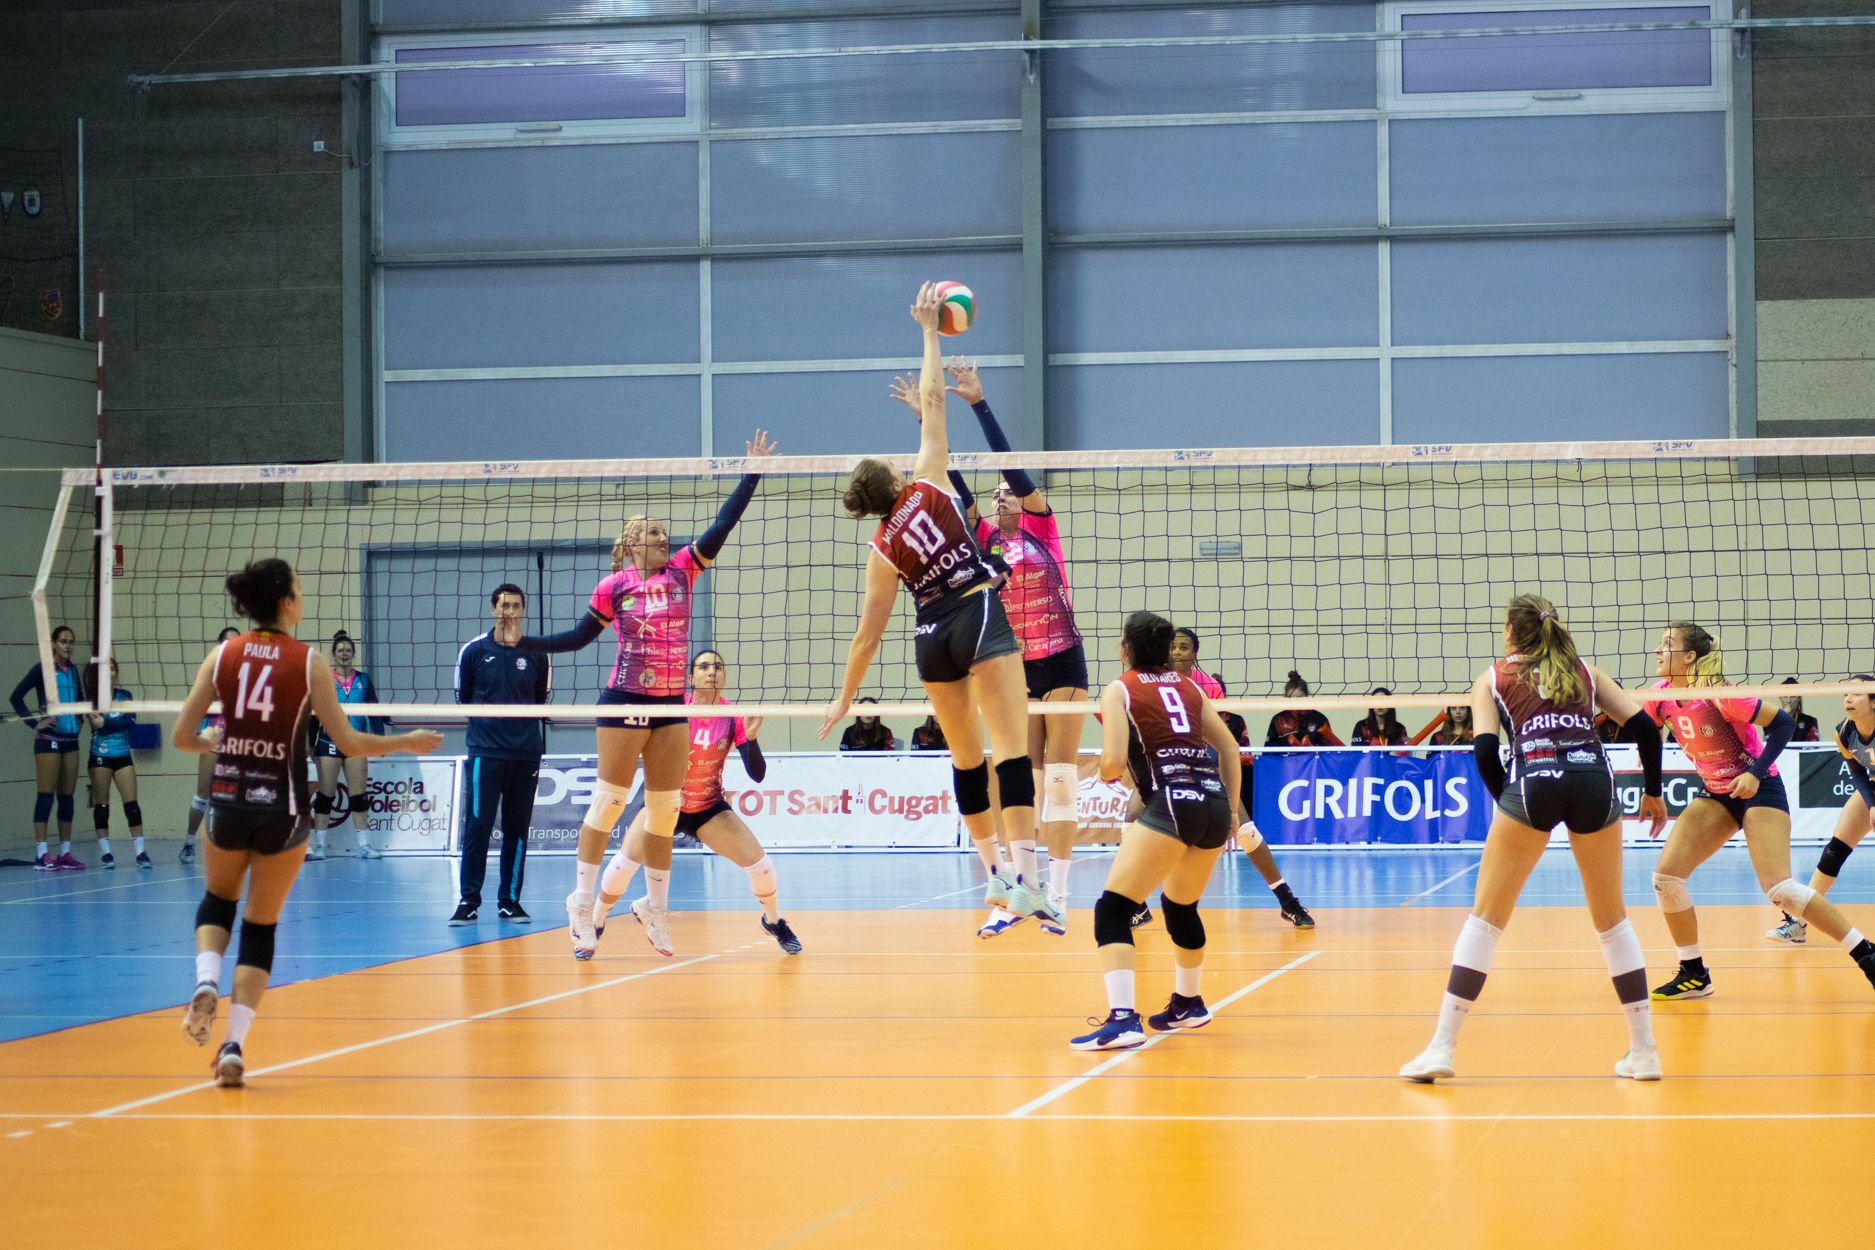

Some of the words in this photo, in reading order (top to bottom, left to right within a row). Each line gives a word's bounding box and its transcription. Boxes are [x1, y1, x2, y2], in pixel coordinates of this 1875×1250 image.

[902, 509, 946, 565] 10
[243, 642, 280, 660] PAULA
[234, 661, 275, 722] 14
[1158, 686, 1191, 733] 9
[1521, 713, 1592, 736] GRIFOLS
[1677, 716, 1696, 739] 9
[693, 728, 710, 751] 4
[1172, 789, 1205, 802] DSV
[1278, 776, 1468, 821] GRIFOLS
[1833, 780, 1854, 795] de
[787, 789, 852, 816] Sant
[868, 788, 951, 821] Cugat
[397, 813, 447, 836] Cugat
[528, 826, 581, 843] Transpo
